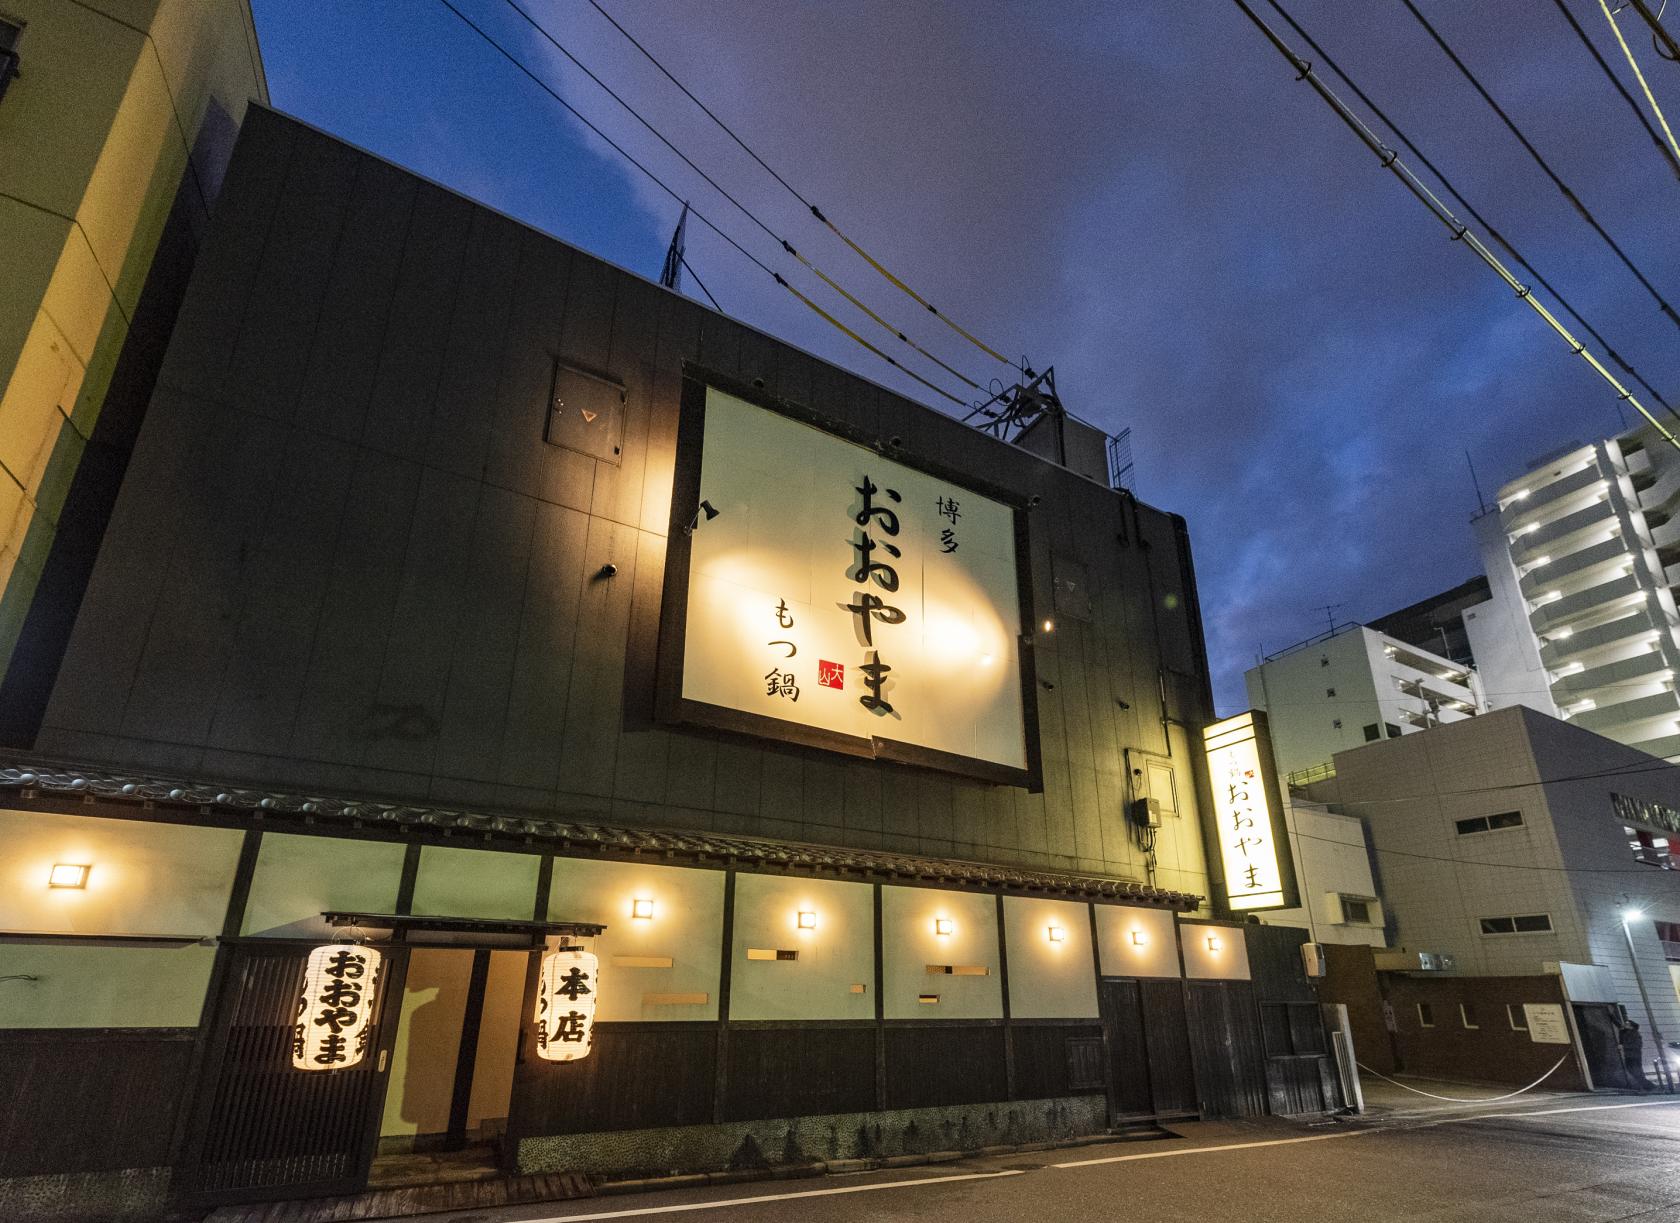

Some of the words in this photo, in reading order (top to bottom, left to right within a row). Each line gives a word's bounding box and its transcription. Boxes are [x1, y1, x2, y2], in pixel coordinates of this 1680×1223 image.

[936, 495, 961, 553] 博多
[848, 475, 906, 714] おおやま
[765, 598, 800, 703] もつ鍋
[1227, 781, 1262, 888] おおやま
[314, 951, 366, 1064] おおやま
[549, 967, 592, 1043] 本店
